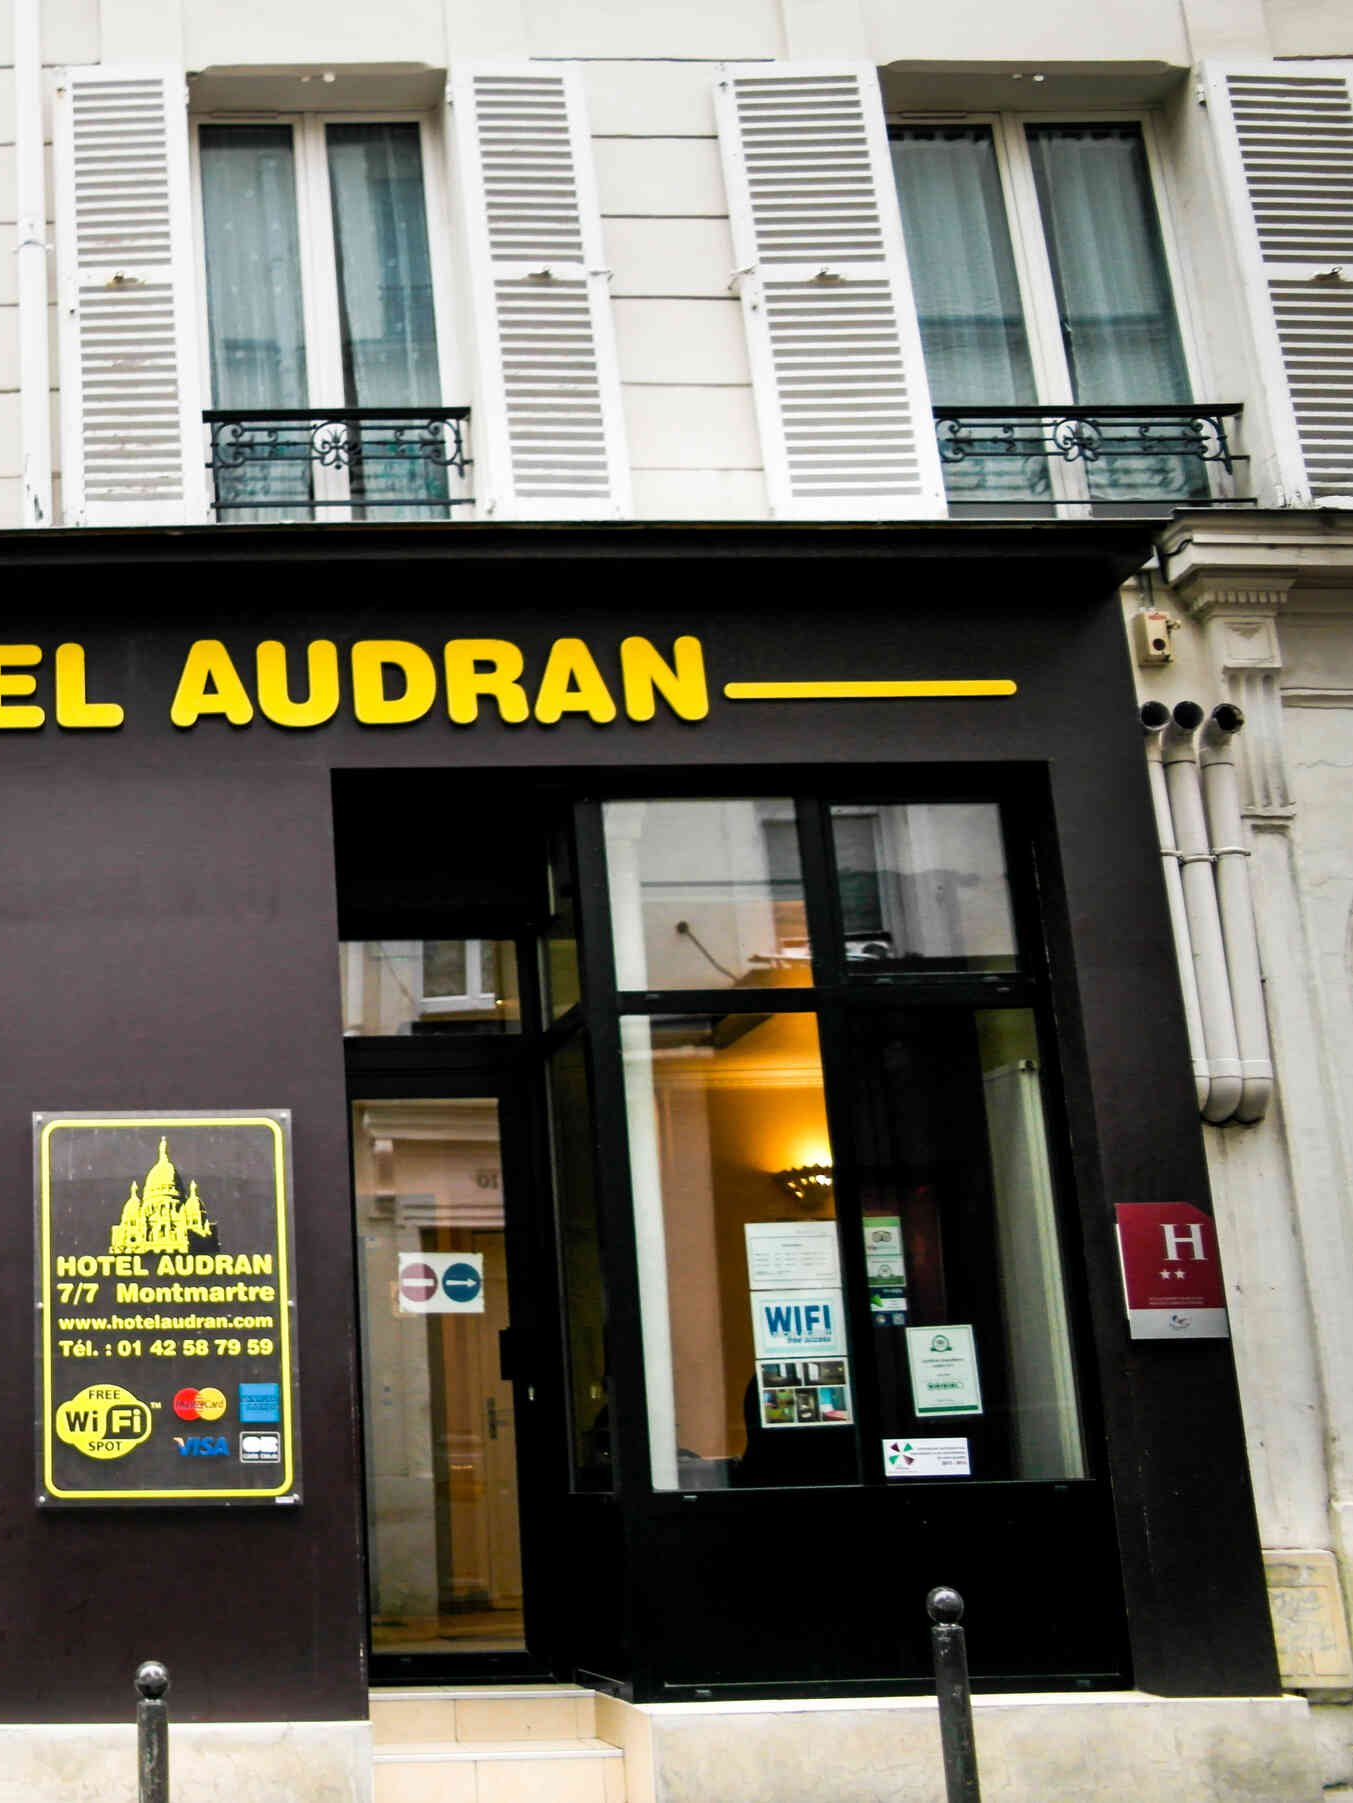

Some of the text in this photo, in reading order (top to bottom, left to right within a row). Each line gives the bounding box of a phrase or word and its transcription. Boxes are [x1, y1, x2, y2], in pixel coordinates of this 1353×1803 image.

[169, 635, 710, 728] AUDRAN
[1160, 1223, 1208, 1261] H
[56, 1254, 273, 1277] HOTEL AUDRAN
[57, 1282, 275, 1304] 7/7 Montmartre
[58, 1314, 273, 1331] www.hotelaudran.com
[764, 1304, 832, 1335] WIFI
[59, 1340, 98, 1358] Tél.
[117, 1340, 141, 1357] 01
[150, 1340, 177, 1357] 42
[182, 1340, 209, 1356] 58
[215, 1340, 241, 1356] 79
[247, 1339, 273, 1356] 59
[88, 1389, 121, 1400] FREE
[88, 1440, 122, 1452] SPOT
[174, 1436, 230, 1457] VISA
